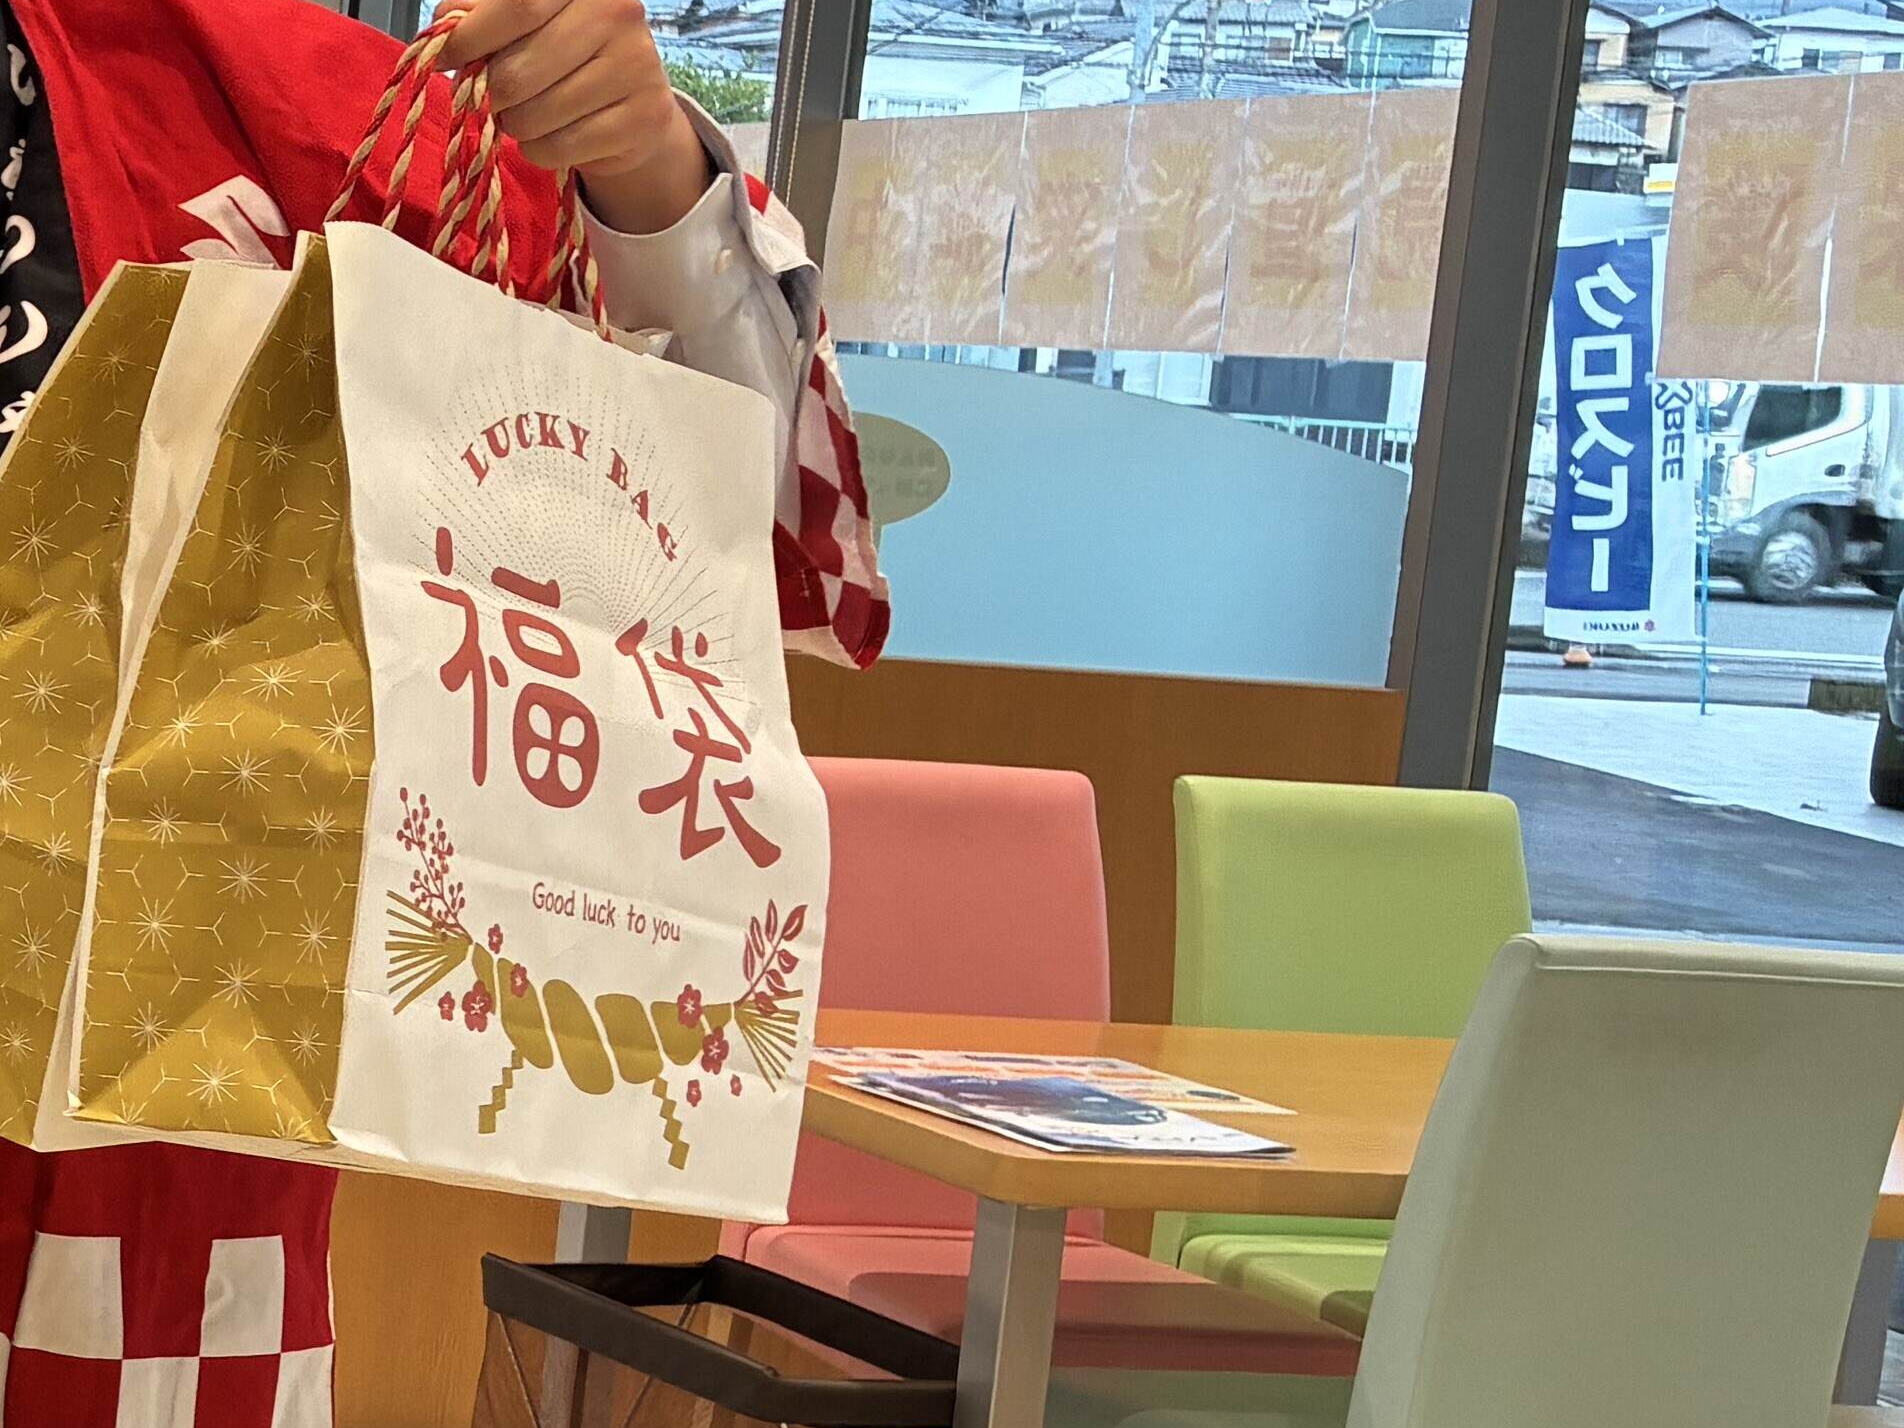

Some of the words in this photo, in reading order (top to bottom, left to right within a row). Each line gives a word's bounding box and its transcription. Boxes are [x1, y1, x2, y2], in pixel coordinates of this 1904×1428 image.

[460, 410, 591, 487] LUCKY
[605, 447, 678, 562] BAG
[420, 525, 782, 869] 福袋
[532, 881, 576, 918] Good
[582, 892, 617, 929] luck
[626, 903, 647, 935] to
[651, 915, 681, 945] you
